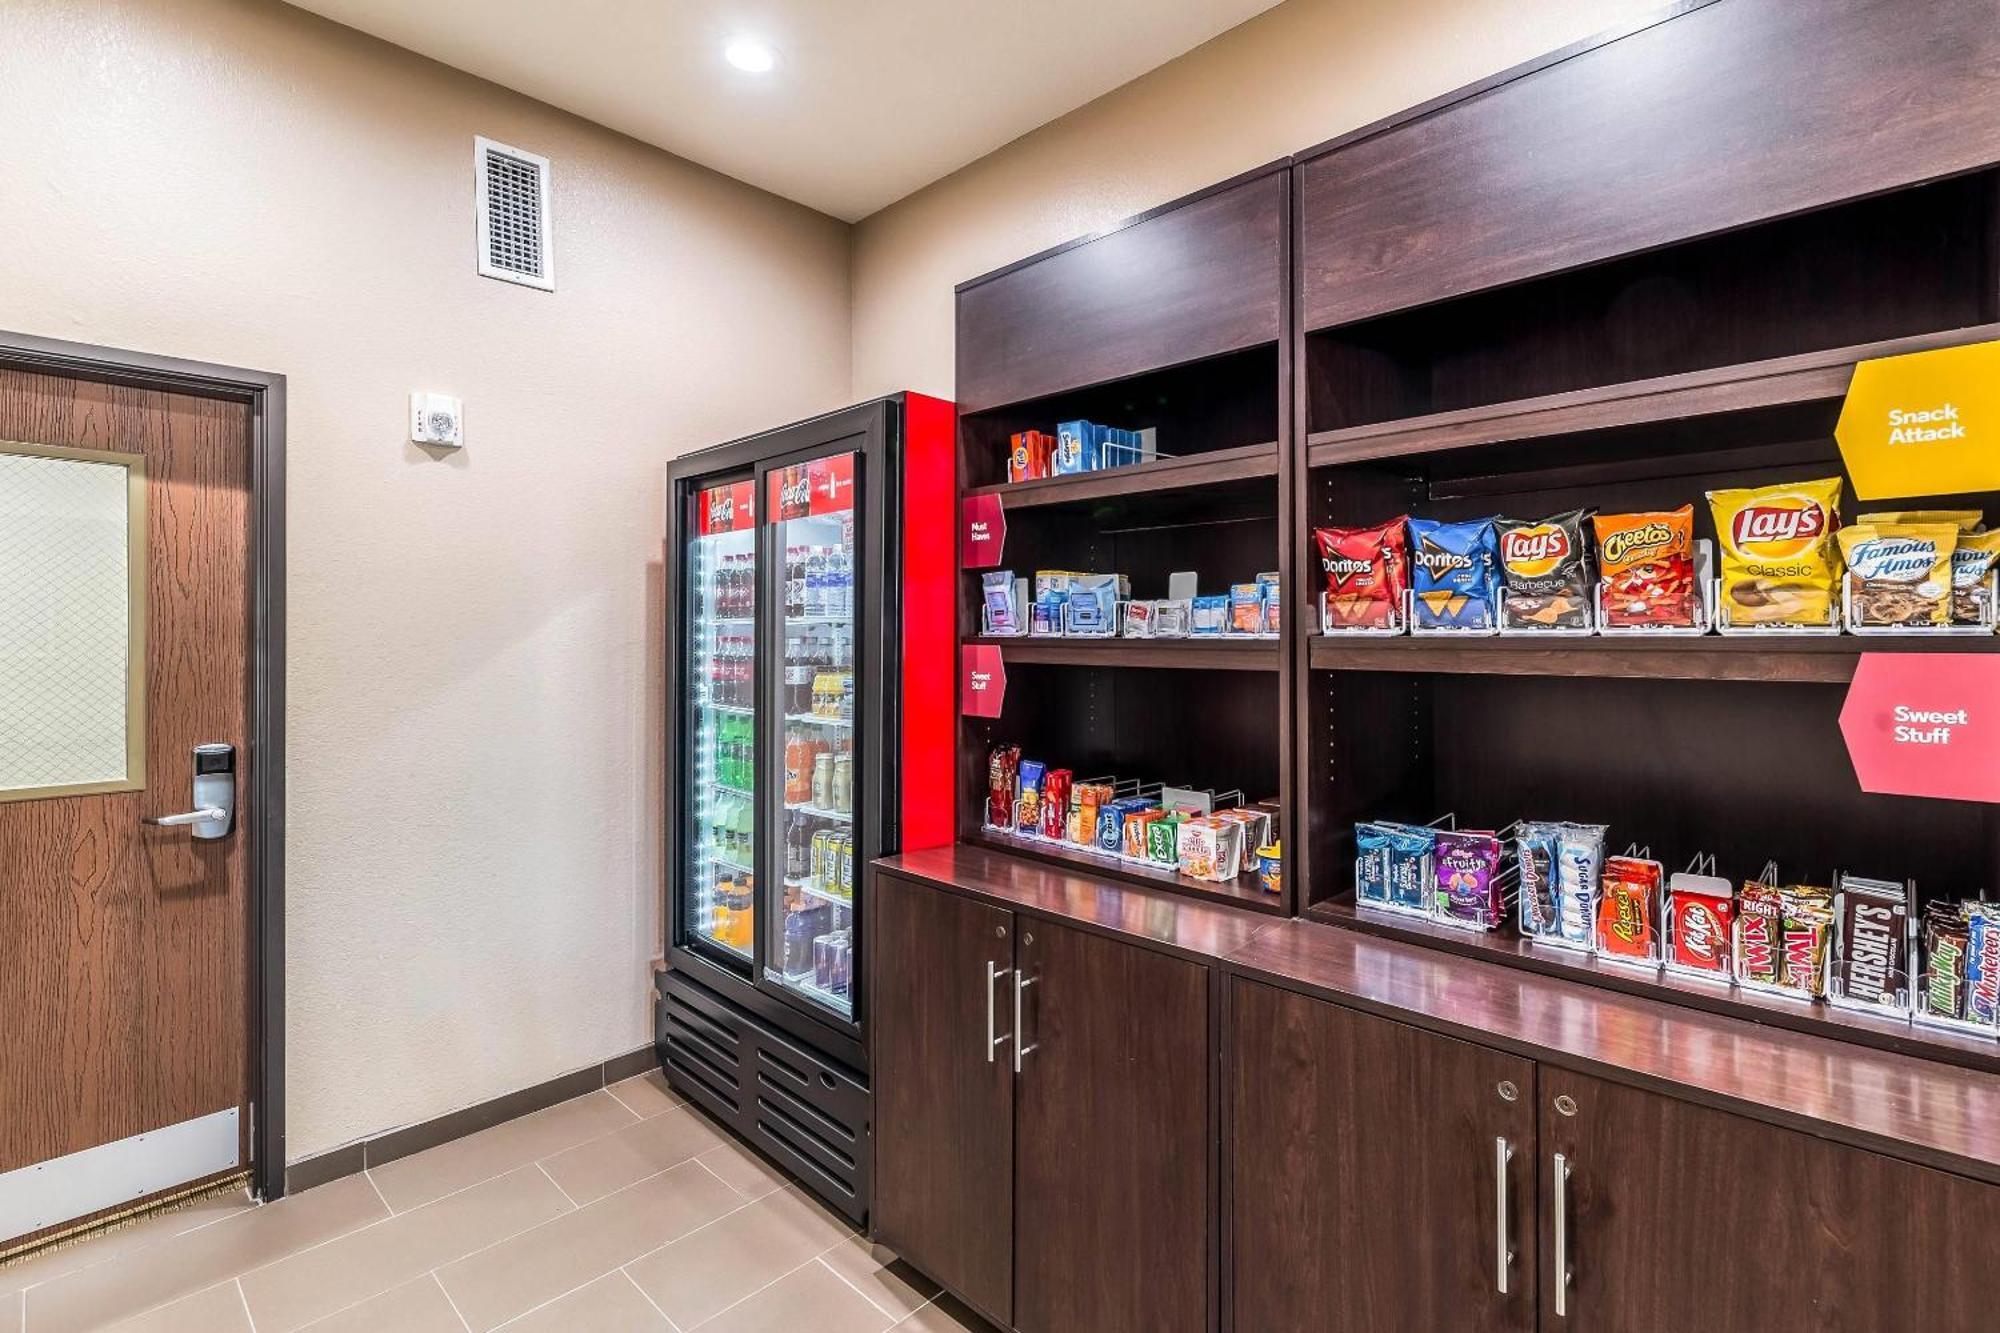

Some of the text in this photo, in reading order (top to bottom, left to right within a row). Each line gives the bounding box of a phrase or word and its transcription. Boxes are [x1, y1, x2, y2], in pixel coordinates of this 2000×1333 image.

[1888, 403, 1959, 426] Snack
[1888, 421, 1967, 445] Attack
[1604, 523, 1672, 562] Cheetos
[1414, 550, 1473, 569] Doritos
[1849, 540, 1936, 568] Famous
[1321, 557, 1373, 574] Doritos
[1747, 562, 1814, 577] Classic
[1865, 556, 1936, 579] Amos
[1509, 579, 1566, 590] Barbecue
[1893, 705, 1968, 725] Sweet
[1893, 725, 1951, 744] Stuff
[1743, 899, 1778, 917] RIGHT
[1744, 915, 1774, 974] TWIX
[1848, 904, 1892, 1000] HERSHEY'S
